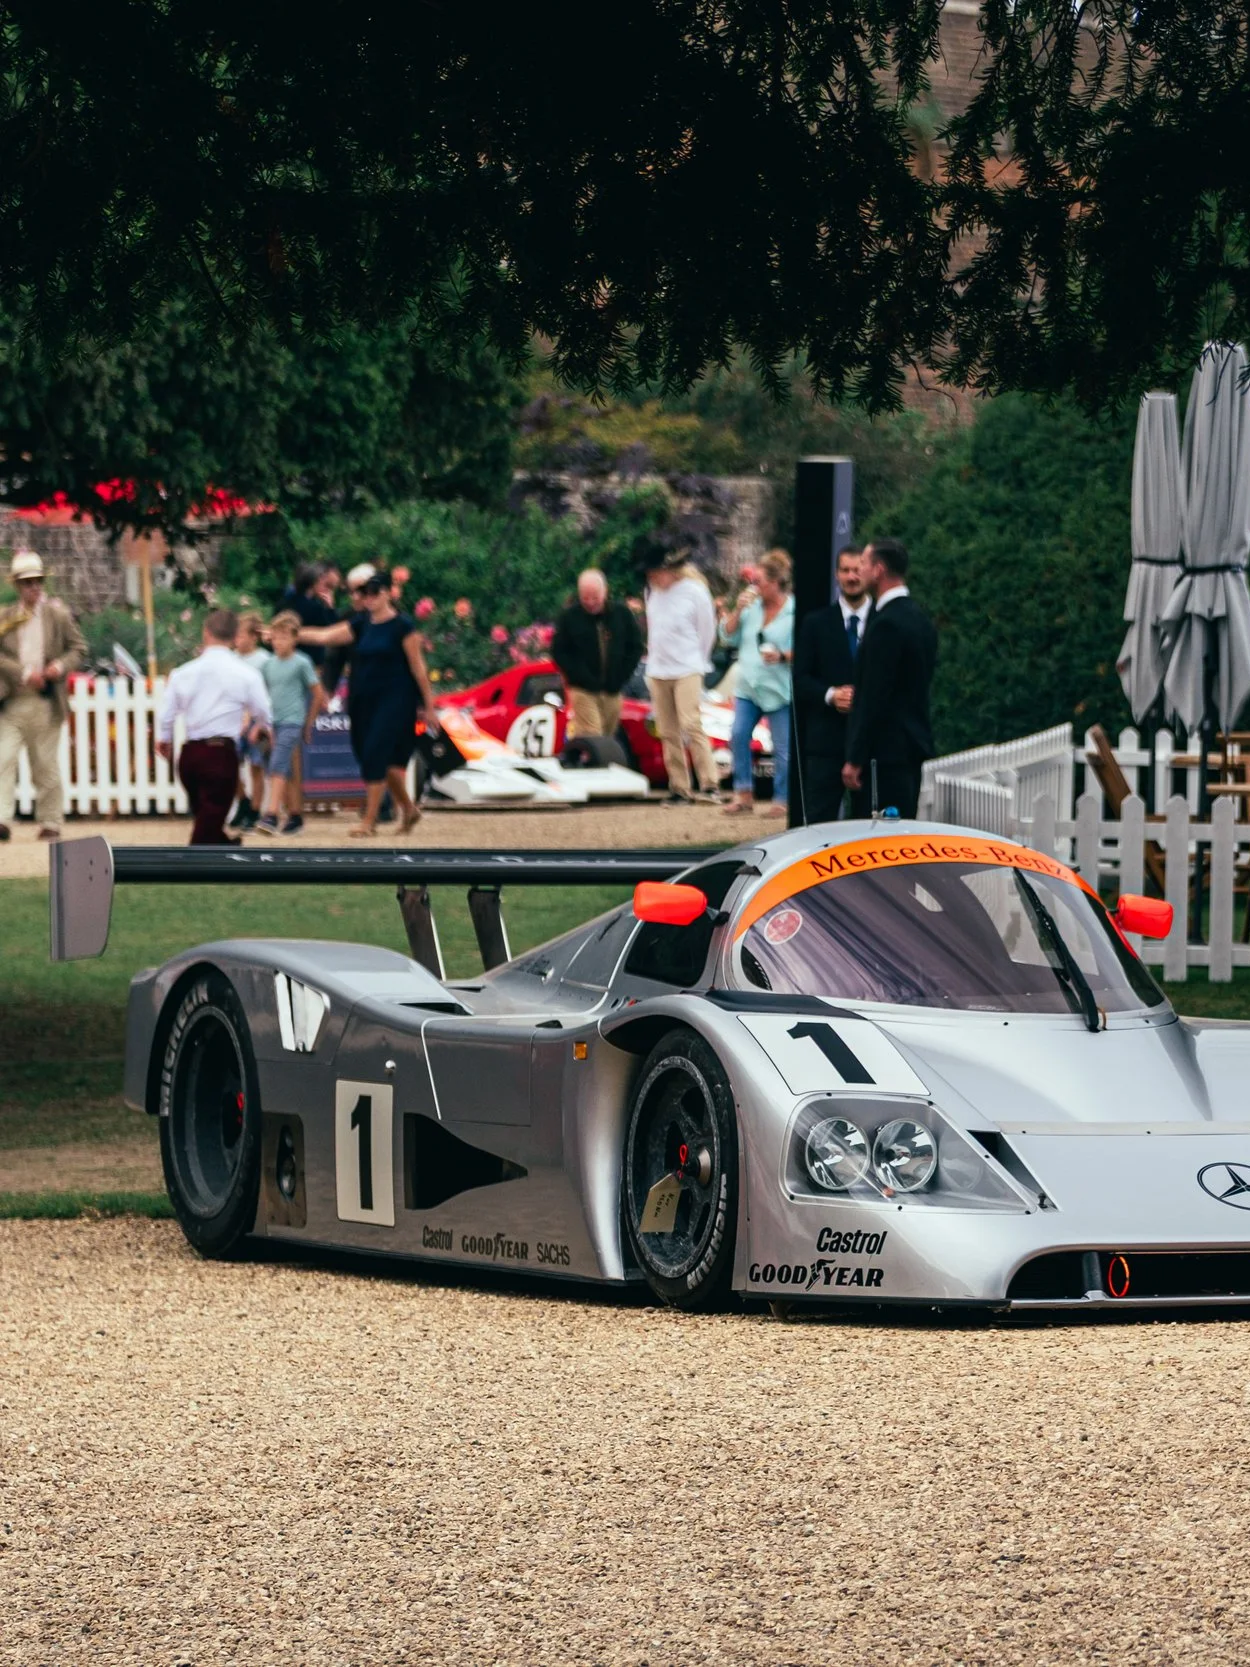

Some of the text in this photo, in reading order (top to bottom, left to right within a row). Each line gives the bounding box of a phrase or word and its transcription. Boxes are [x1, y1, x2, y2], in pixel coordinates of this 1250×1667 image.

[810, 843, 1068, 880] Mercedes-Benz
[786, 1021, 878, 1085] 1
[350, 1094, 374, 1211] 1
[422, 1224, 453, 1251] Castrol
[536, 1241, 570, 1266] SACHS
[686, 1173, 728, 1291] MICHELIN
[816, 1226, 888, 1255] Castrol
